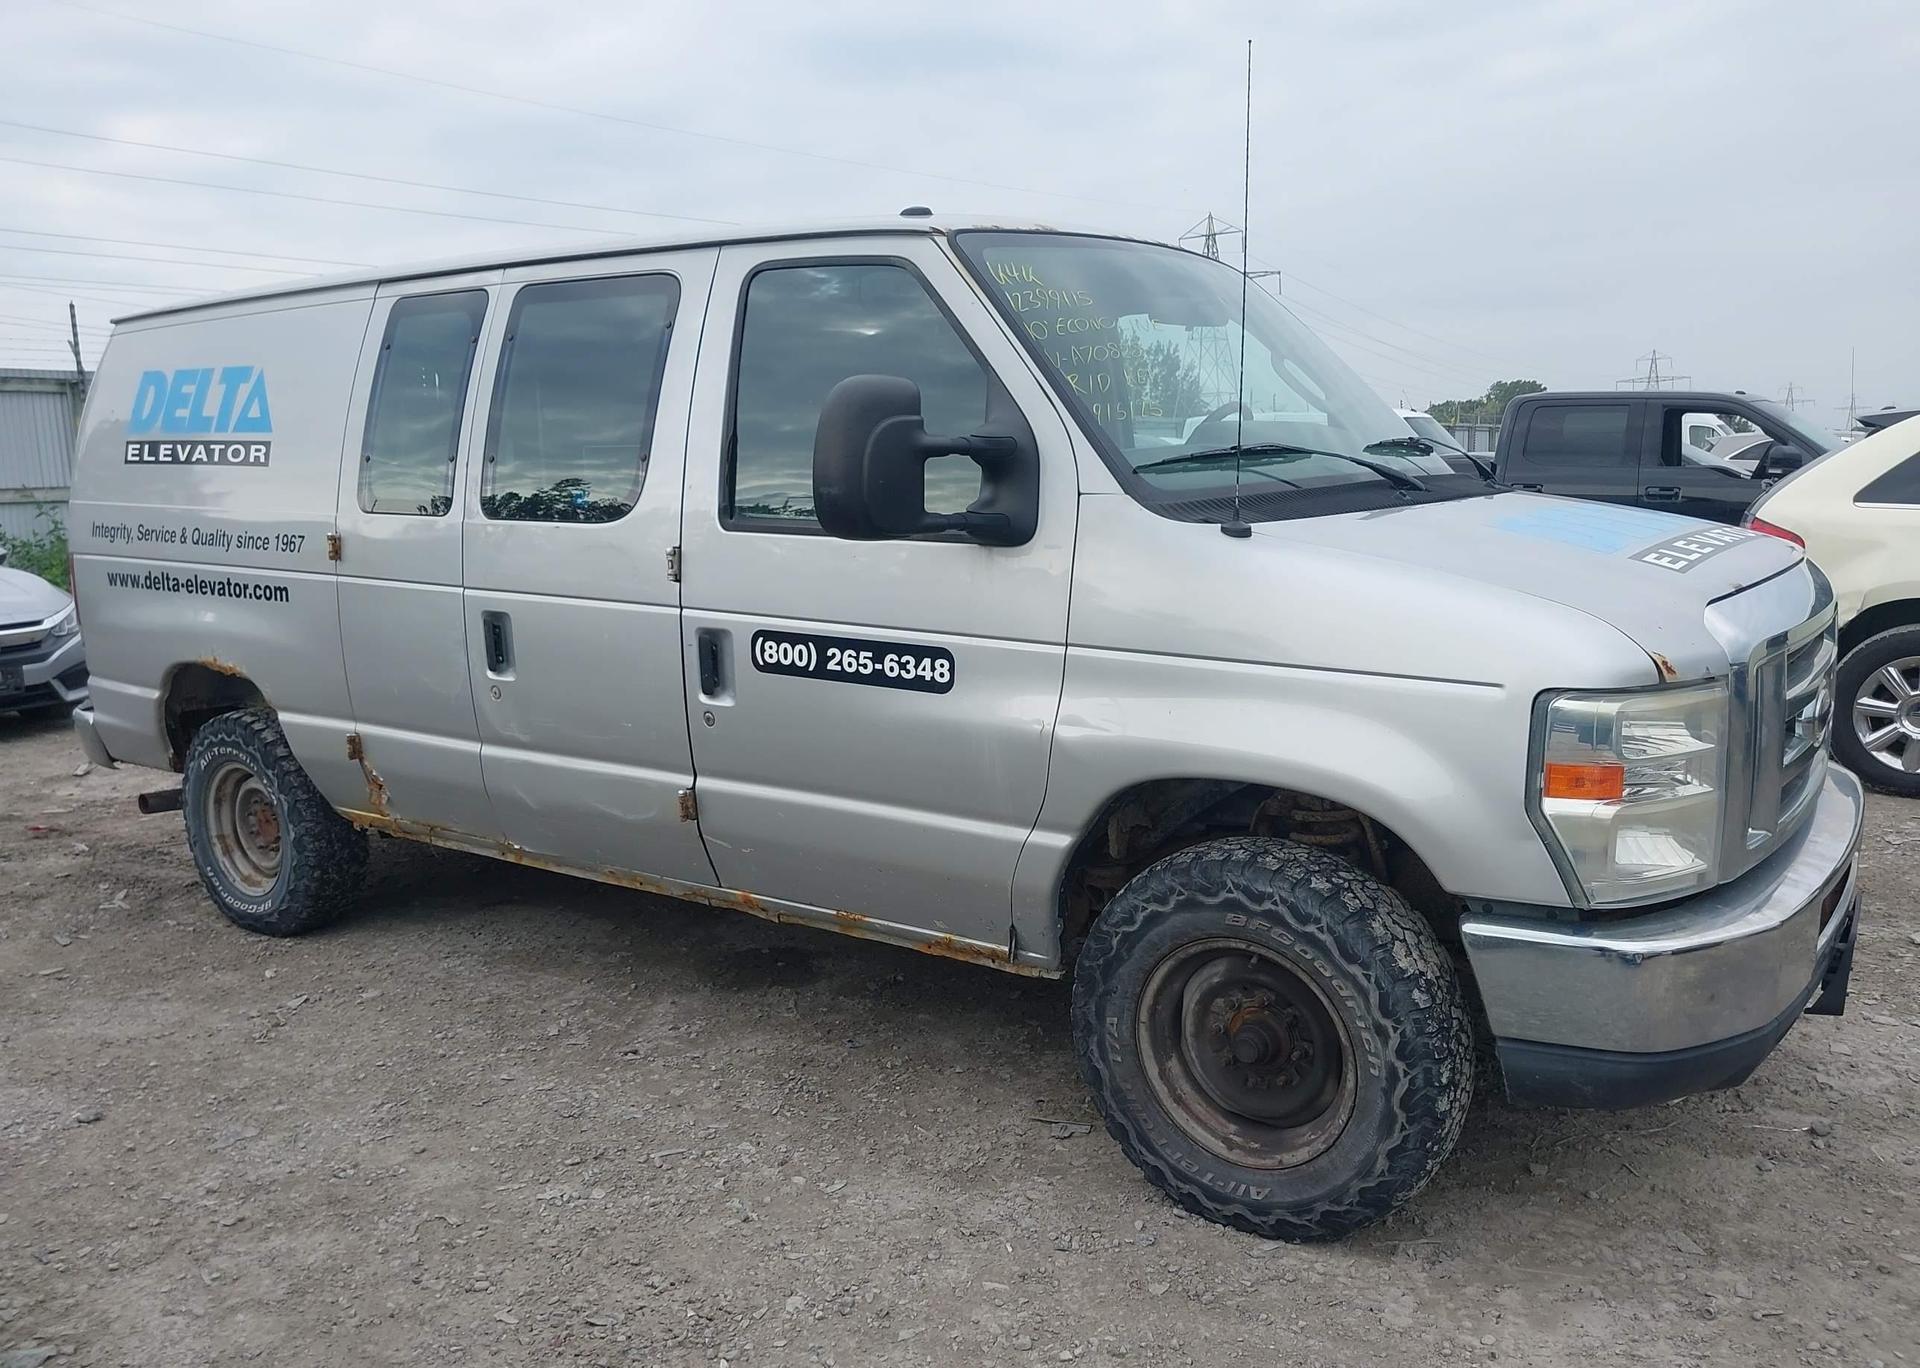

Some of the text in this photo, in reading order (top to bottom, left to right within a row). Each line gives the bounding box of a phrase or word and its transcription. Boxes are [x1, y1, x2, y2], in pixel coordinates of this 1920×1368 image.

[1005, 288, 1094, 312] 12399115
[127, 366, 273, 434] DELTA
[126, 443, 267, 464] ELEVATOR
[137, 524, 176, 544] Service
[180, 528, 188, 544] &
[191, 527, 233, 553] Quality
[236, 530, 270, 551] since
[274, 533, 305, 553] 1967
[107, 570, 290, 603] www.delta-elevator.com
[755, 636, 951, 683] (800) 265-6348
